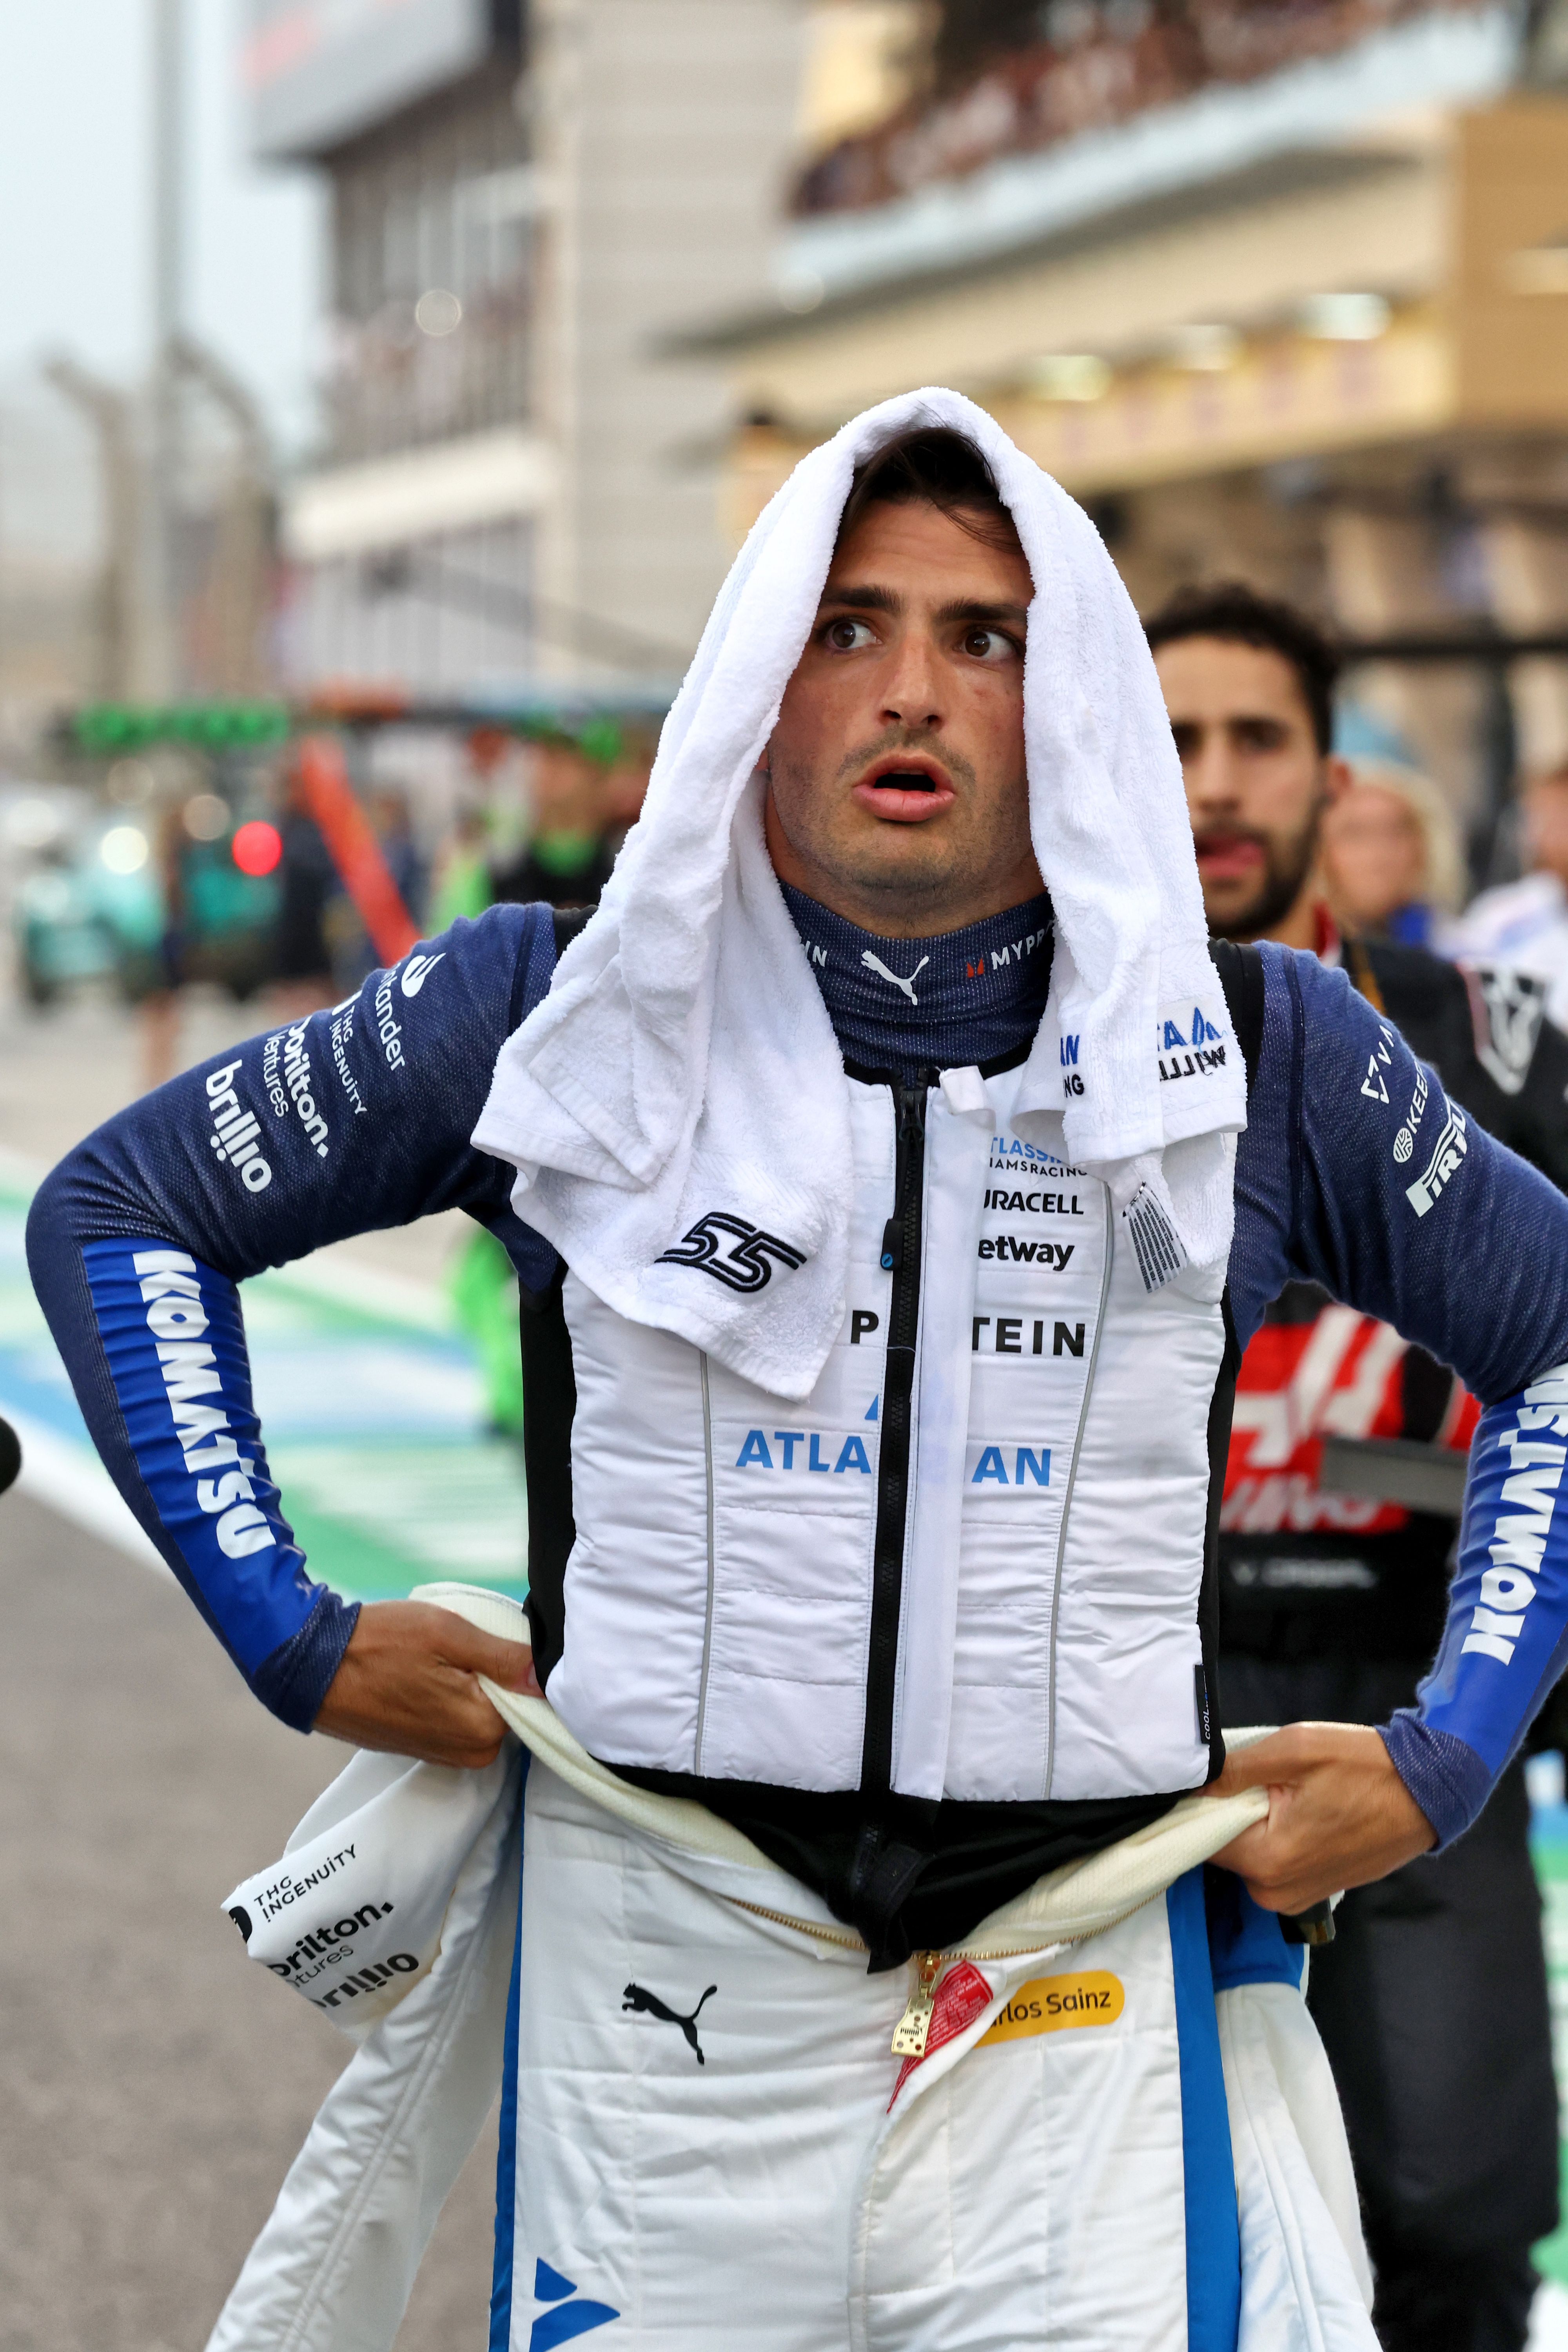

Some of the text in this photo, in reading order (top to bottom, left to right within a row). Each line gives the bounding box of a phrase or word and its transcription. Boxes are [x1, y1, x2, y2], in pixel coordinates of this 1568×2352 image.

[655, 1211, 807, 1293] 55
[978, 1236, 1075, 1271] etway
[133, 1249, 277, 1560] KOMATSU
[254, 1876, 292, 1906] THG
[1046, 1987, 1111, 2015] Sainz
